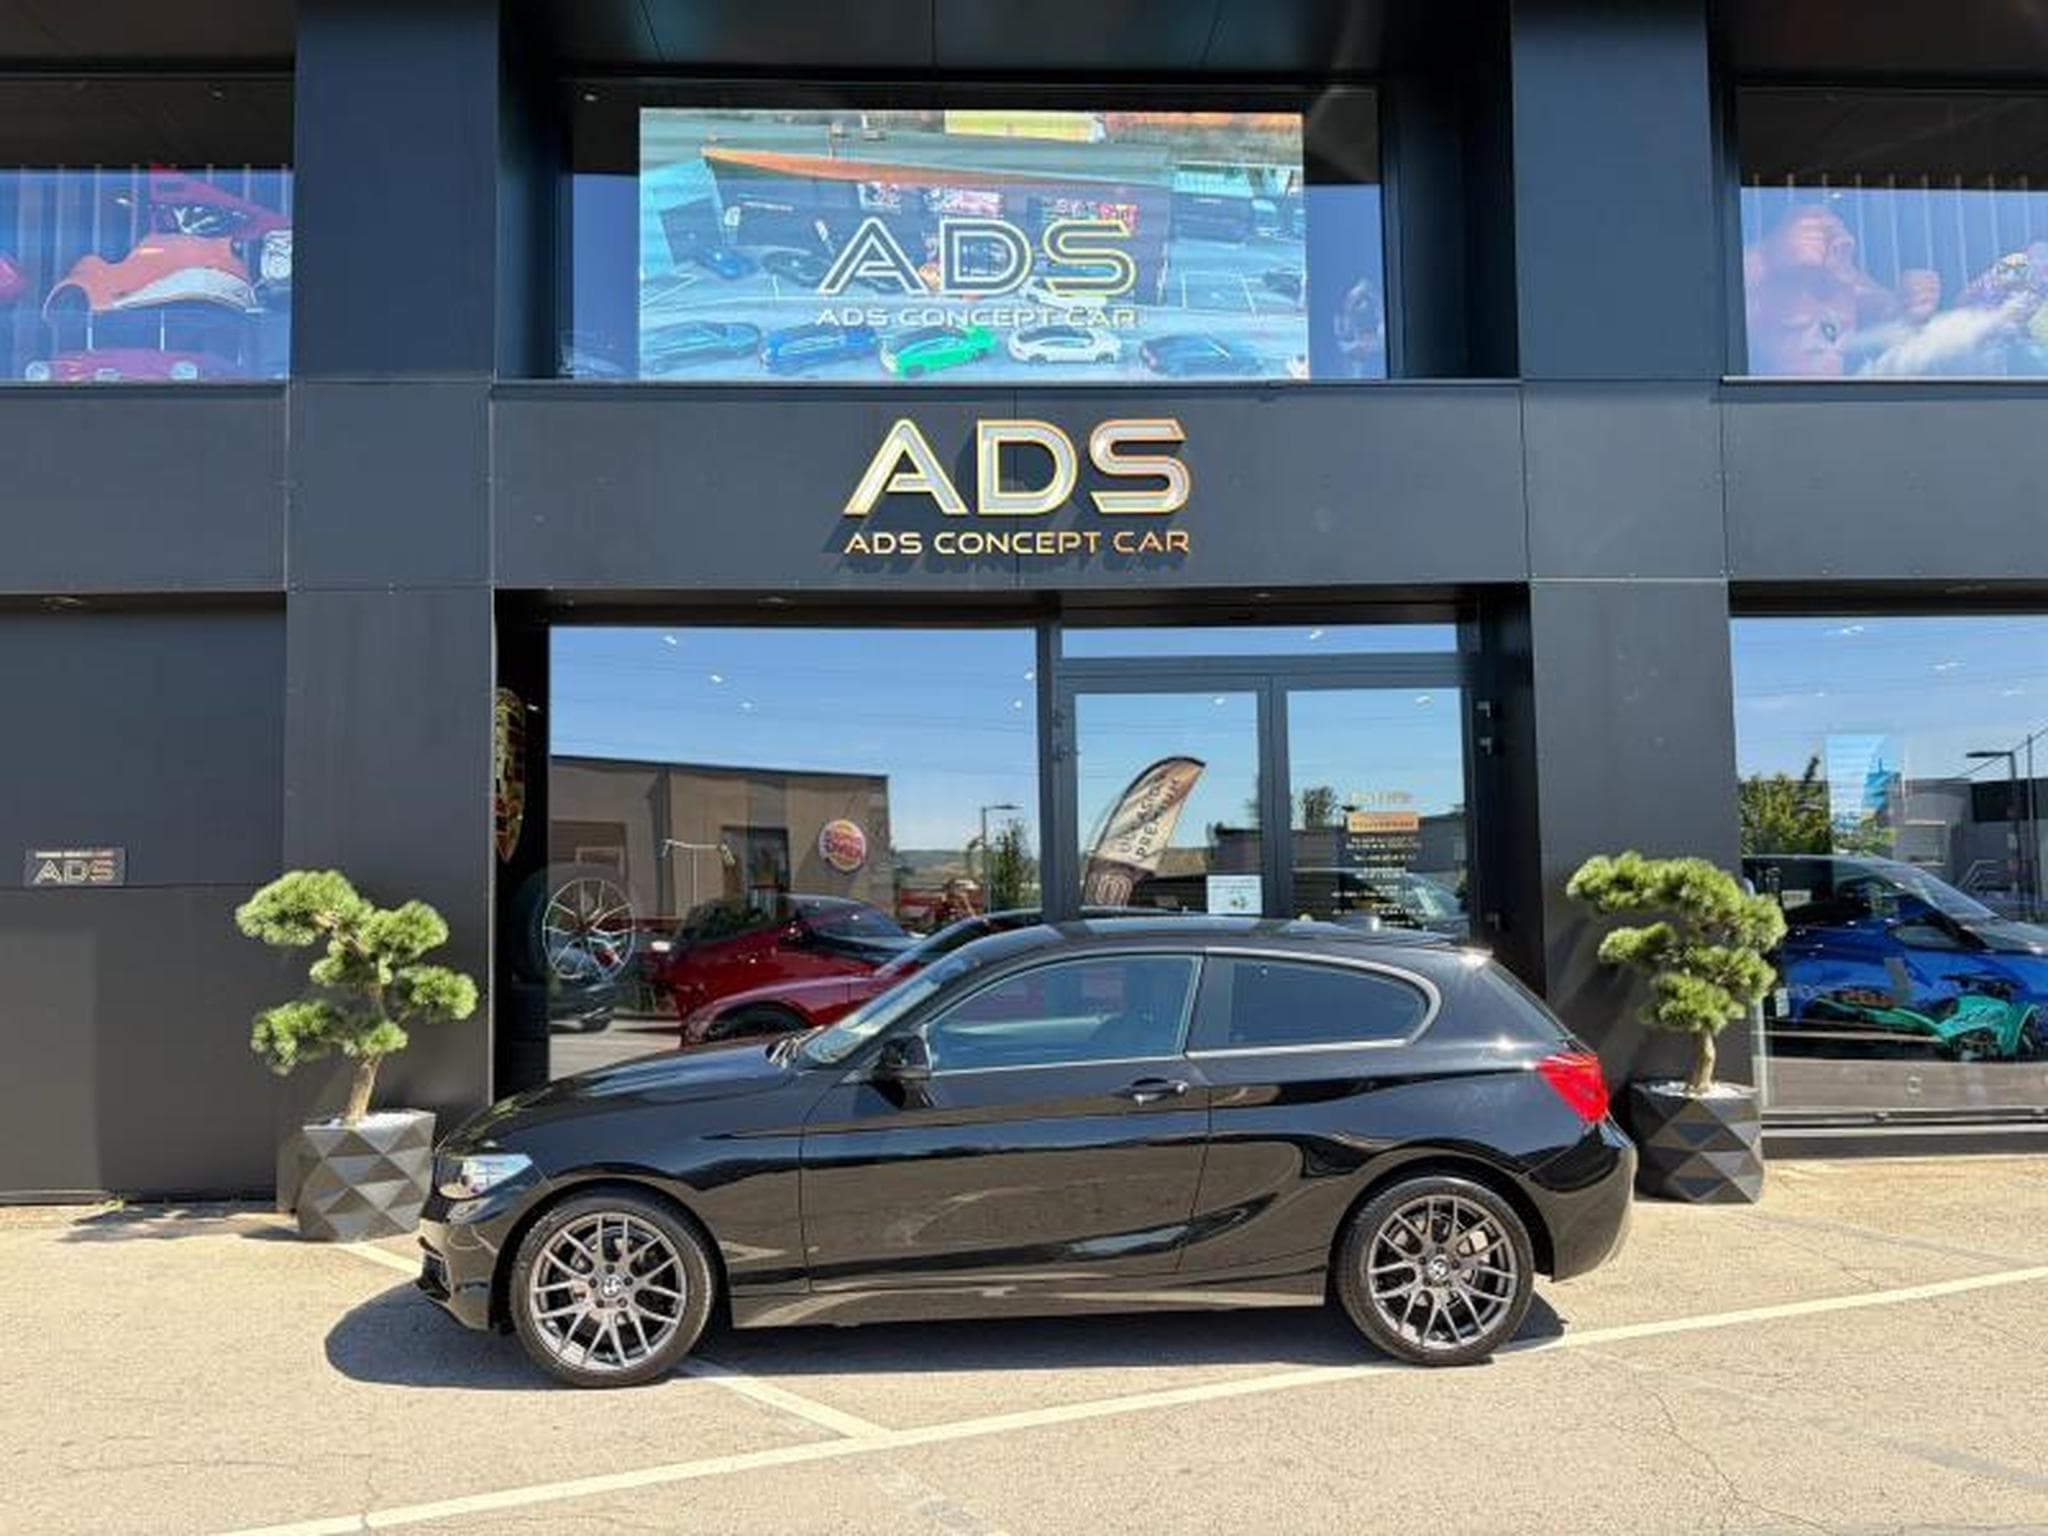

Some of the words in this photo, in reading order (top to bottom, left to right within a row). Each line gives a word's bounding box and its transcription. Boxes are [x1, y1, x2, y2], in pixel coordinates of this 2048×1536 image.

[816, 217, 1138, 297] ADS
[815, 307, 888, 327] ADS
[899, 308, 1052, 328] CONCEPT
[1064, 307, 1137, 328] CAR
[843, 418, 1191, 516] ADS
[844, 531, 923, 554] ADS
[934, 531, 1101, 554] CONCEPT
[1113, 531, 1191, 553] CAR
[33, 859, 113, 884] ADS
